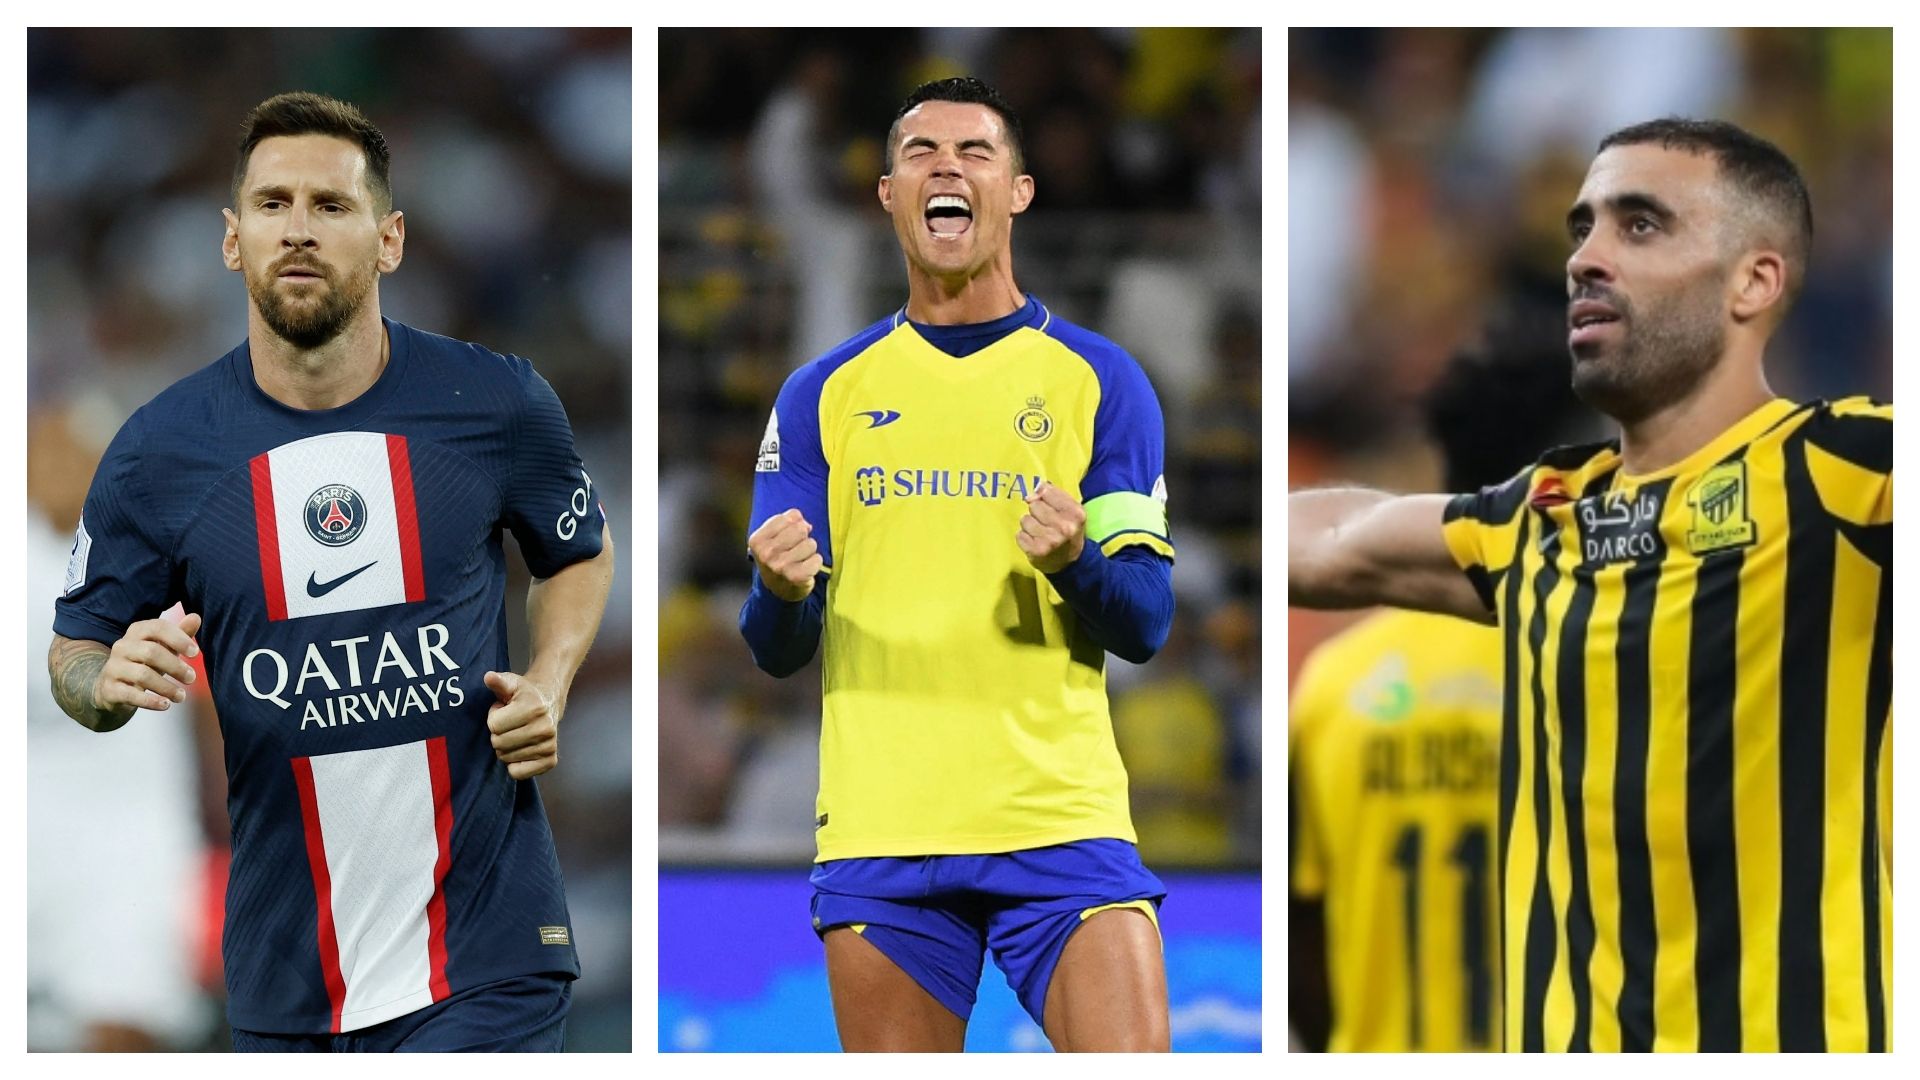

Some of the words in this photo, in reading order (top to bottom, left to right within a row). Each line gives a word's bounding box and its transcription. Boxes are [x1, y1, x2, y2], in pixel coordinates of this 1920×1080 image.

[313, 488, 353, 505] PARIS
[556, 461, 593, 541] GOA
[1586, 532, 1656, 561] DARCO
[242, 623, 461, 710] QATAR
[300, 675, 465, 731] AIRWAYS
[1388, 819, 1493, 1051] 11
